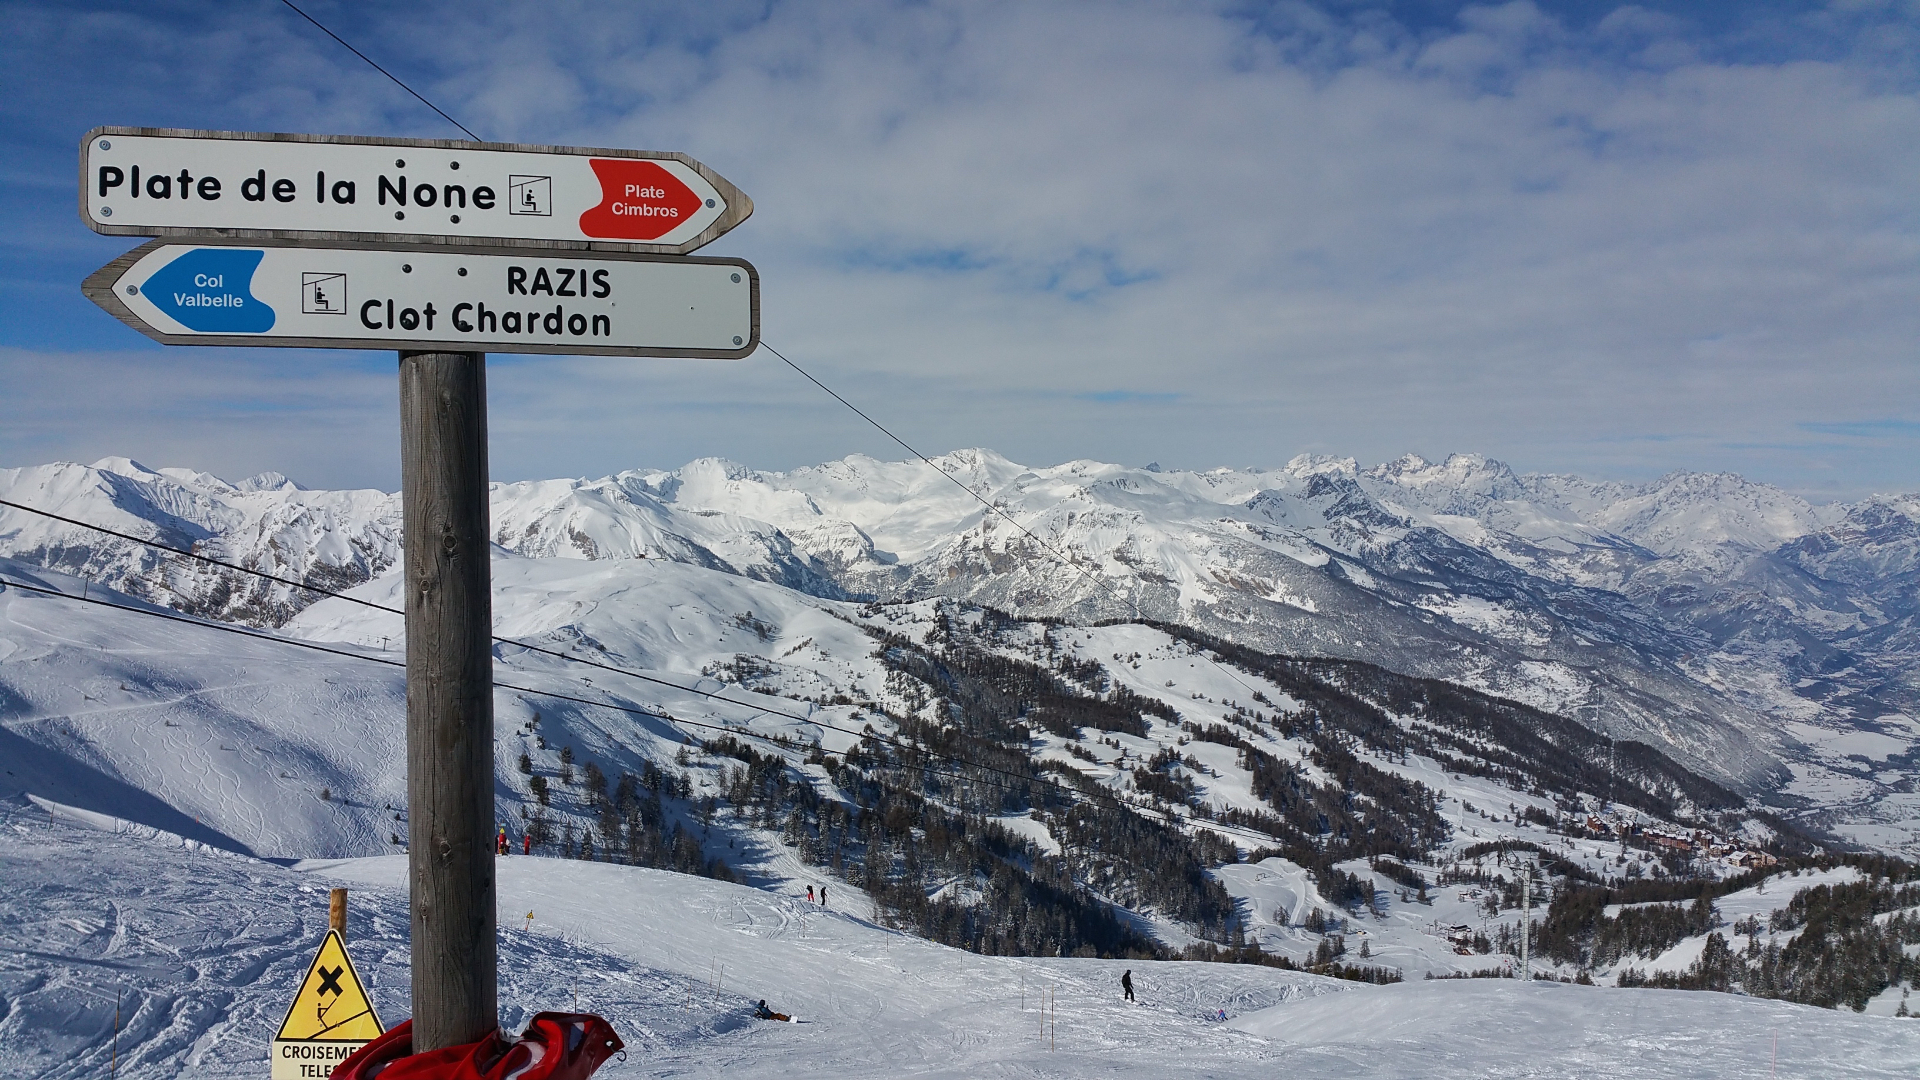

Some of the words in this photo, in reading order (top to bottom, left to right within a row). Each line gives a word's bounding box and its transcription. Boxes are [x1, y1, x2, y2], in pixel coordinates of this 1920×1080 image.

[99, 165, 222, 200] Plate
[241, 169, 296, 202] de
[316, 171, 356, 204] la
[378, 175, 496, 210] None
[625, 184, 665, 199] Plate
[611, 202, 679, 218] Cimbros
[194, 273, 223, 288] Col
[507, 266, 611, 299] RAZIS
[173, 293, 244, 308] Valbelle
[360, 299, 437, 331] Clot
[452, 302, 611, 337] Chardon
[282, 1046, 361, 1060] CROISEME
